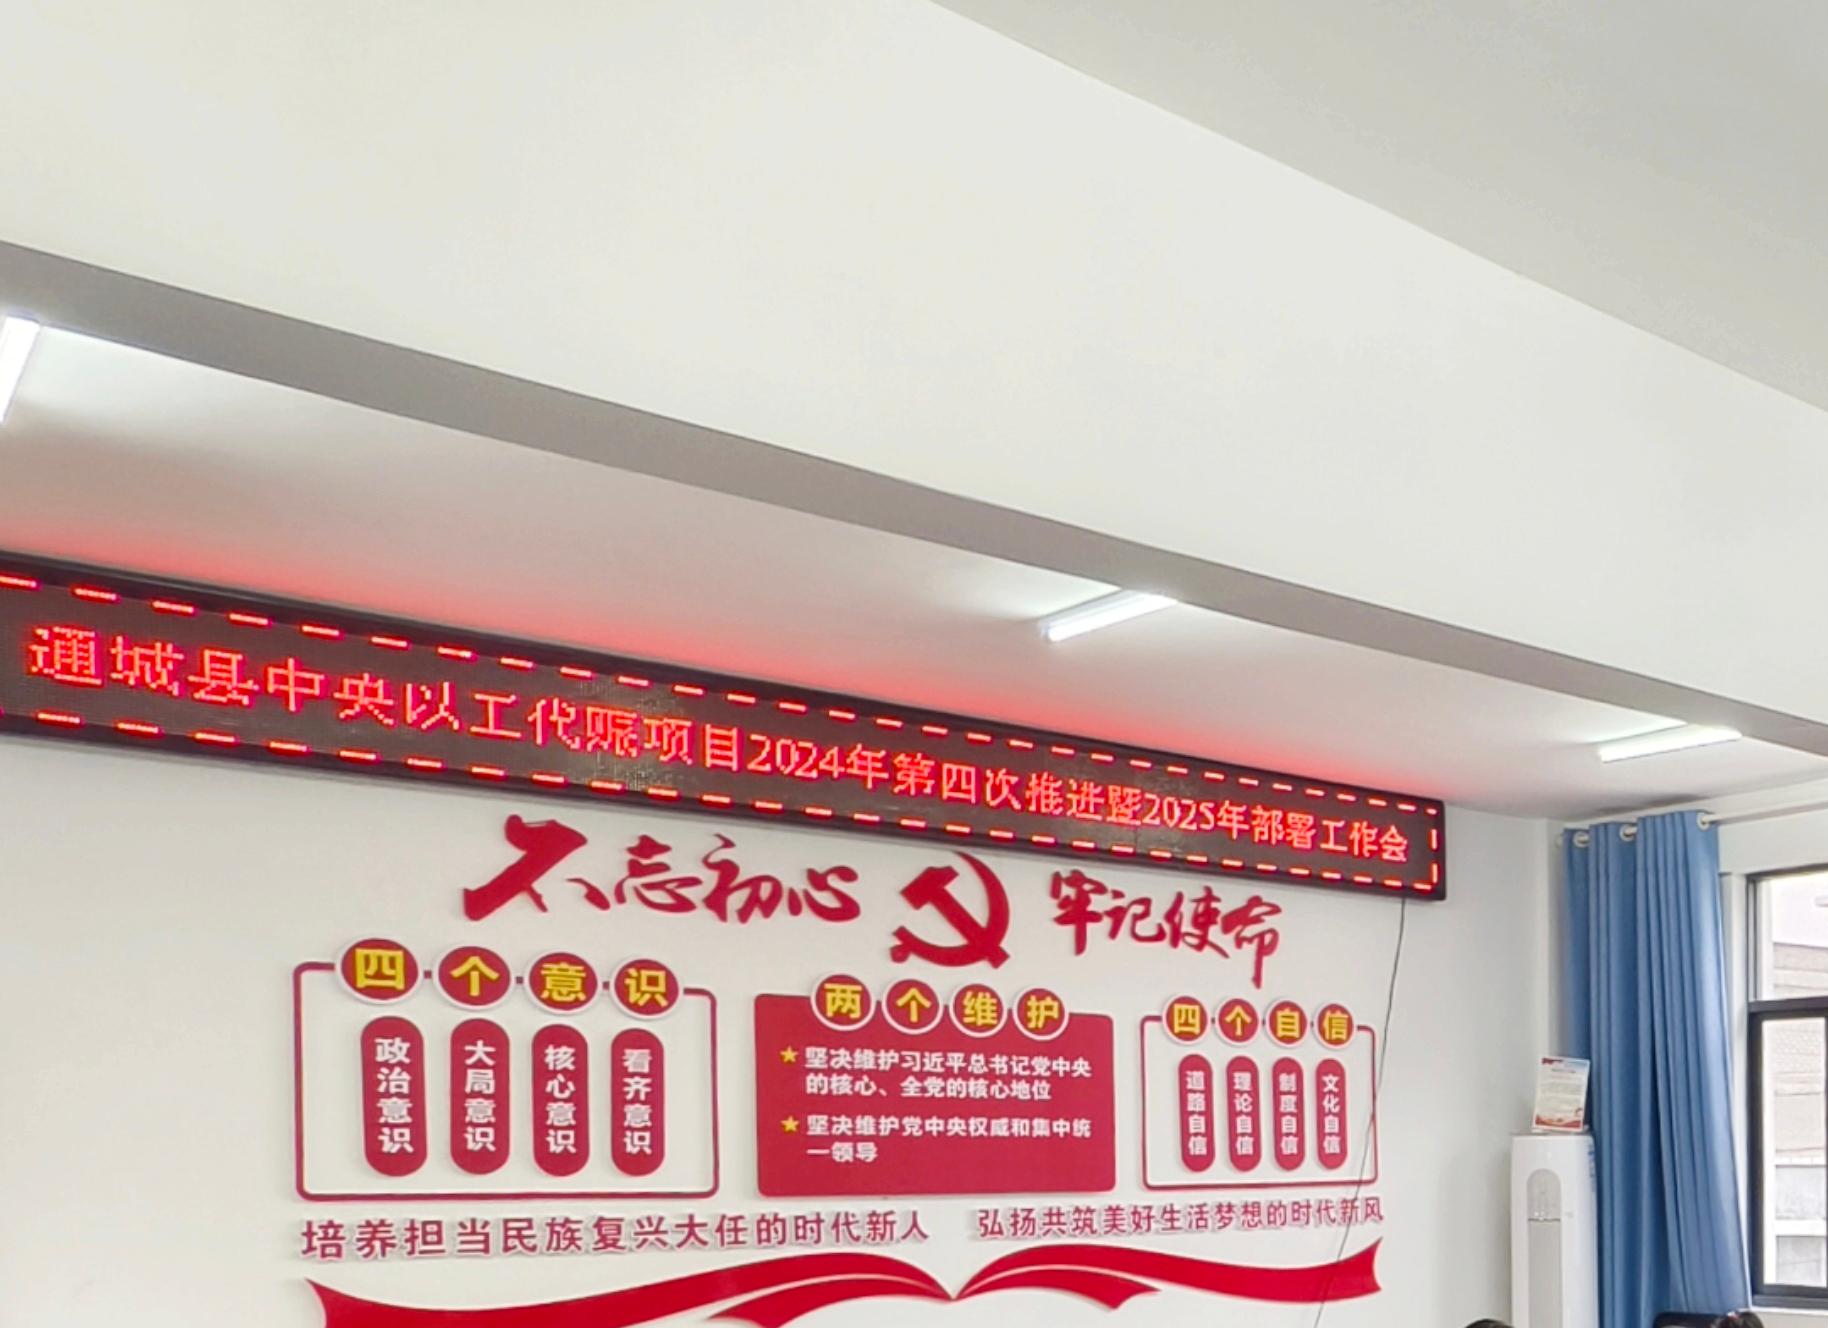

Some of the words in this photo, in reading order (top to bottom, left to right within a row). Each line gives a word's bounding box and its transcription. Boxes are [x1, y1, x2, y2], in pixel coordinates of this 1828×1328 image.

[28, 624, 1408, 864] 通城县中央以工代赈项目2024年第四次推进暨2025年部署工作会
[463, 815, 861, 922] 不忘初心
[1049, 868, 1283, 988] 牢记使命
[355, 948, 668, 1007] 四个意识
[825, 982, 1063, 1029] 两个维护
[805, 1047, 1092, 1077] 坚决维护习近平总书记党中央
[1172, 1003, 1350, 1042] 四个自信
[375, 1037, 414, 1153] 政治意识
[464, 1040, 496, 1152] 大局意识
[545, 1045, 576, 1153] 核心意识
[623, 1049, 652, 1154] 看齐意识
[805, 1073, 1052, 1100] 的核心、全党的核心地位
[807, 1115, 1092, 1138] 坚决维护党中央权威和集中统
[1186, 1071, 1207, 1155] 道路自信
[1234, 1072, 1253, 1155] 理论自信
[1279, 1073, 1298, 1155] 制度自信
[1322, 1074, 1340, 1155] 文化自信
[807, 1142, 878, 1162] 一领导
[300, 1211, 929, 1259] 培养担当民族复兴大任的时代新人
[977, 1198, 1384, 1239] 弘扬共筑美好生活梦想的时代新风
